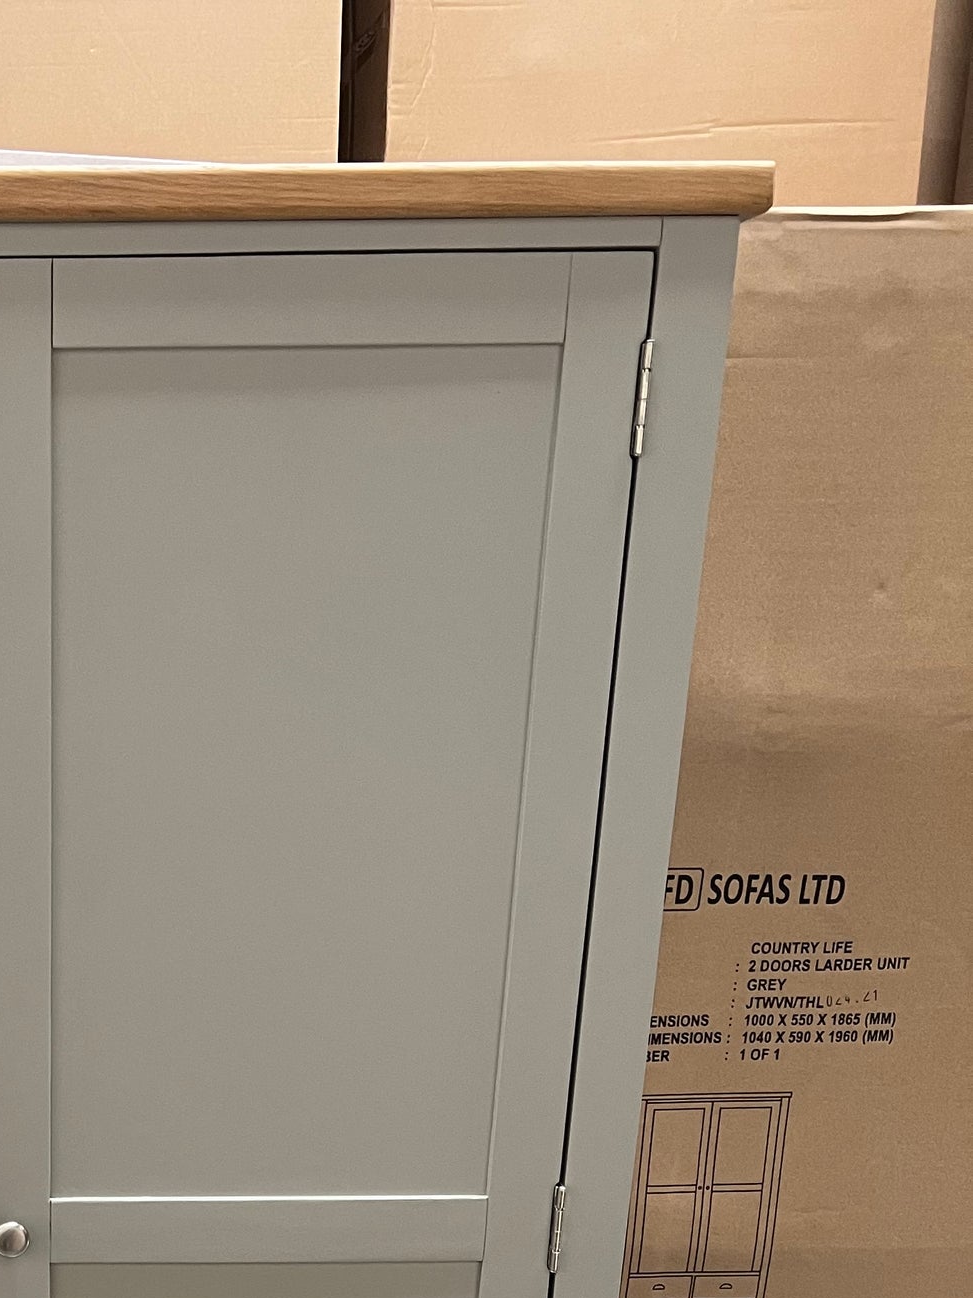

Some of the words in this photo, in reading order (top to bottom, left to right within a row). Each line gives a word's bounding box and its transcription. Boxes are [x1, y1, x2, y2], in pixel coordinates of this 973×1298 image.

[707, 873, 792, 905] SOFAS
[798, 874, 846, 905] LTD
[751, 941, 821, 955] COUNTRY
[823, 941, 853, 954] LIFE
[748, 959, 757, 973] 2
[760, 959, 811, 972] DOORS
[815, 958, 873, 972] LARDER
[877, 957, 910, 971] UNIT
[747, 978, 787, 992] GREY
[744, 1014, 774, 1027] 1000
[777, 1013, 788, 1027] X
[790, 1013, 814, 1026] 550
[816, 1013, 828, 1026] X
[830, 1012, 861, 1026] 1865
[864, 1011, 896, 1029] (MM)
[742, 1031, 772, 1044] 1040
[774, 1030, 786, 1044] X
[788, 1031, 812, 1044] 590
[814, 1030, 825, 1043] X
[828, 1030, 858, 1043] 1960
[862, 1029, 894, 1045] (MM)
[739, 1048, 746, 1061] 1
[750, 1048, 770, 1061] OF
[774, 1048, 780, 1061] 1
